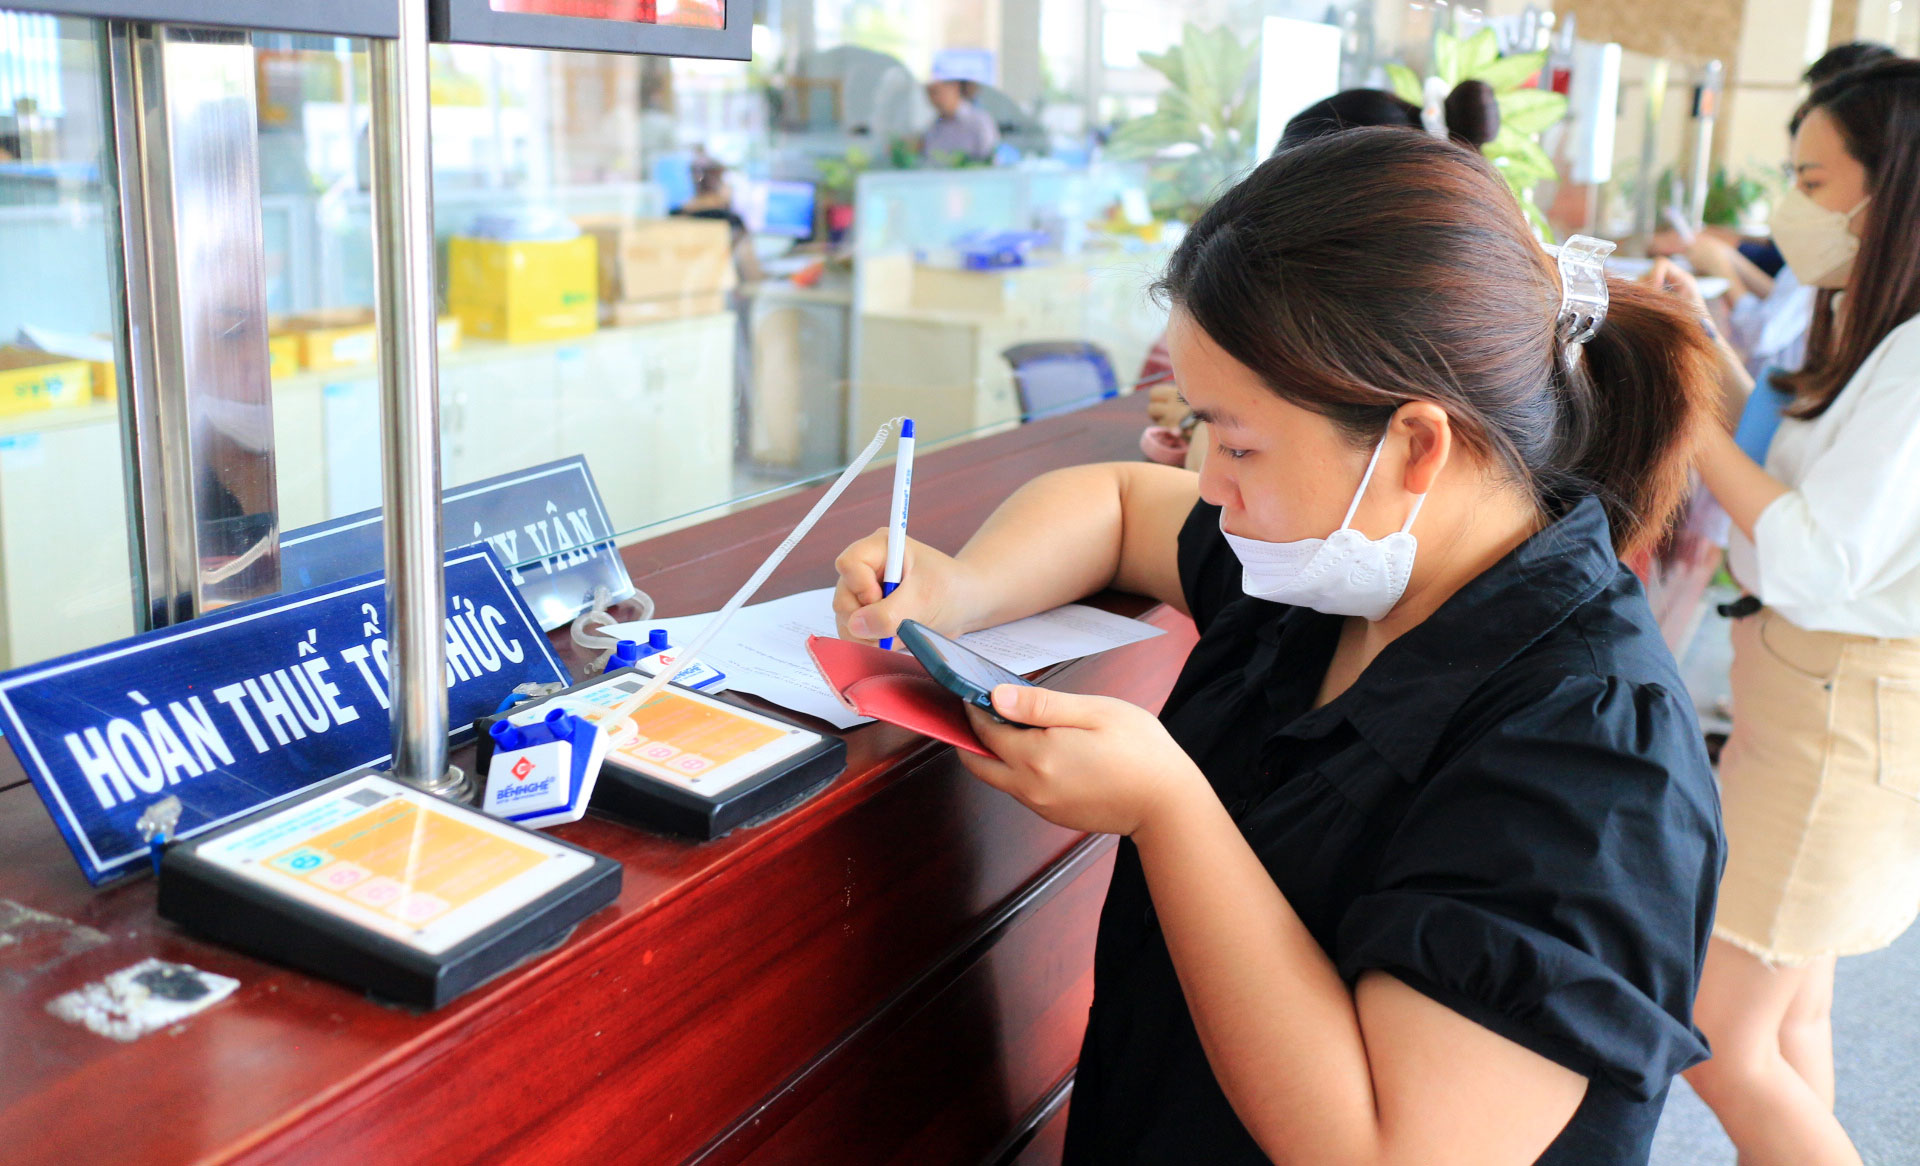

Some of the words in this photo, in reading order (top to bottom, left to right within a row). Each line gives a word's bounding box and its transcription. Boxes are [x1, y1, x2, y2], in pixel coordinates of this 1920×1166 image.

[523, 500, 598, 576] VÂN
[64, 690, 236, 810] HOÀN
[212, 628, 360, 754] THUẾ
[445, 595, 525, 689] HỨC
